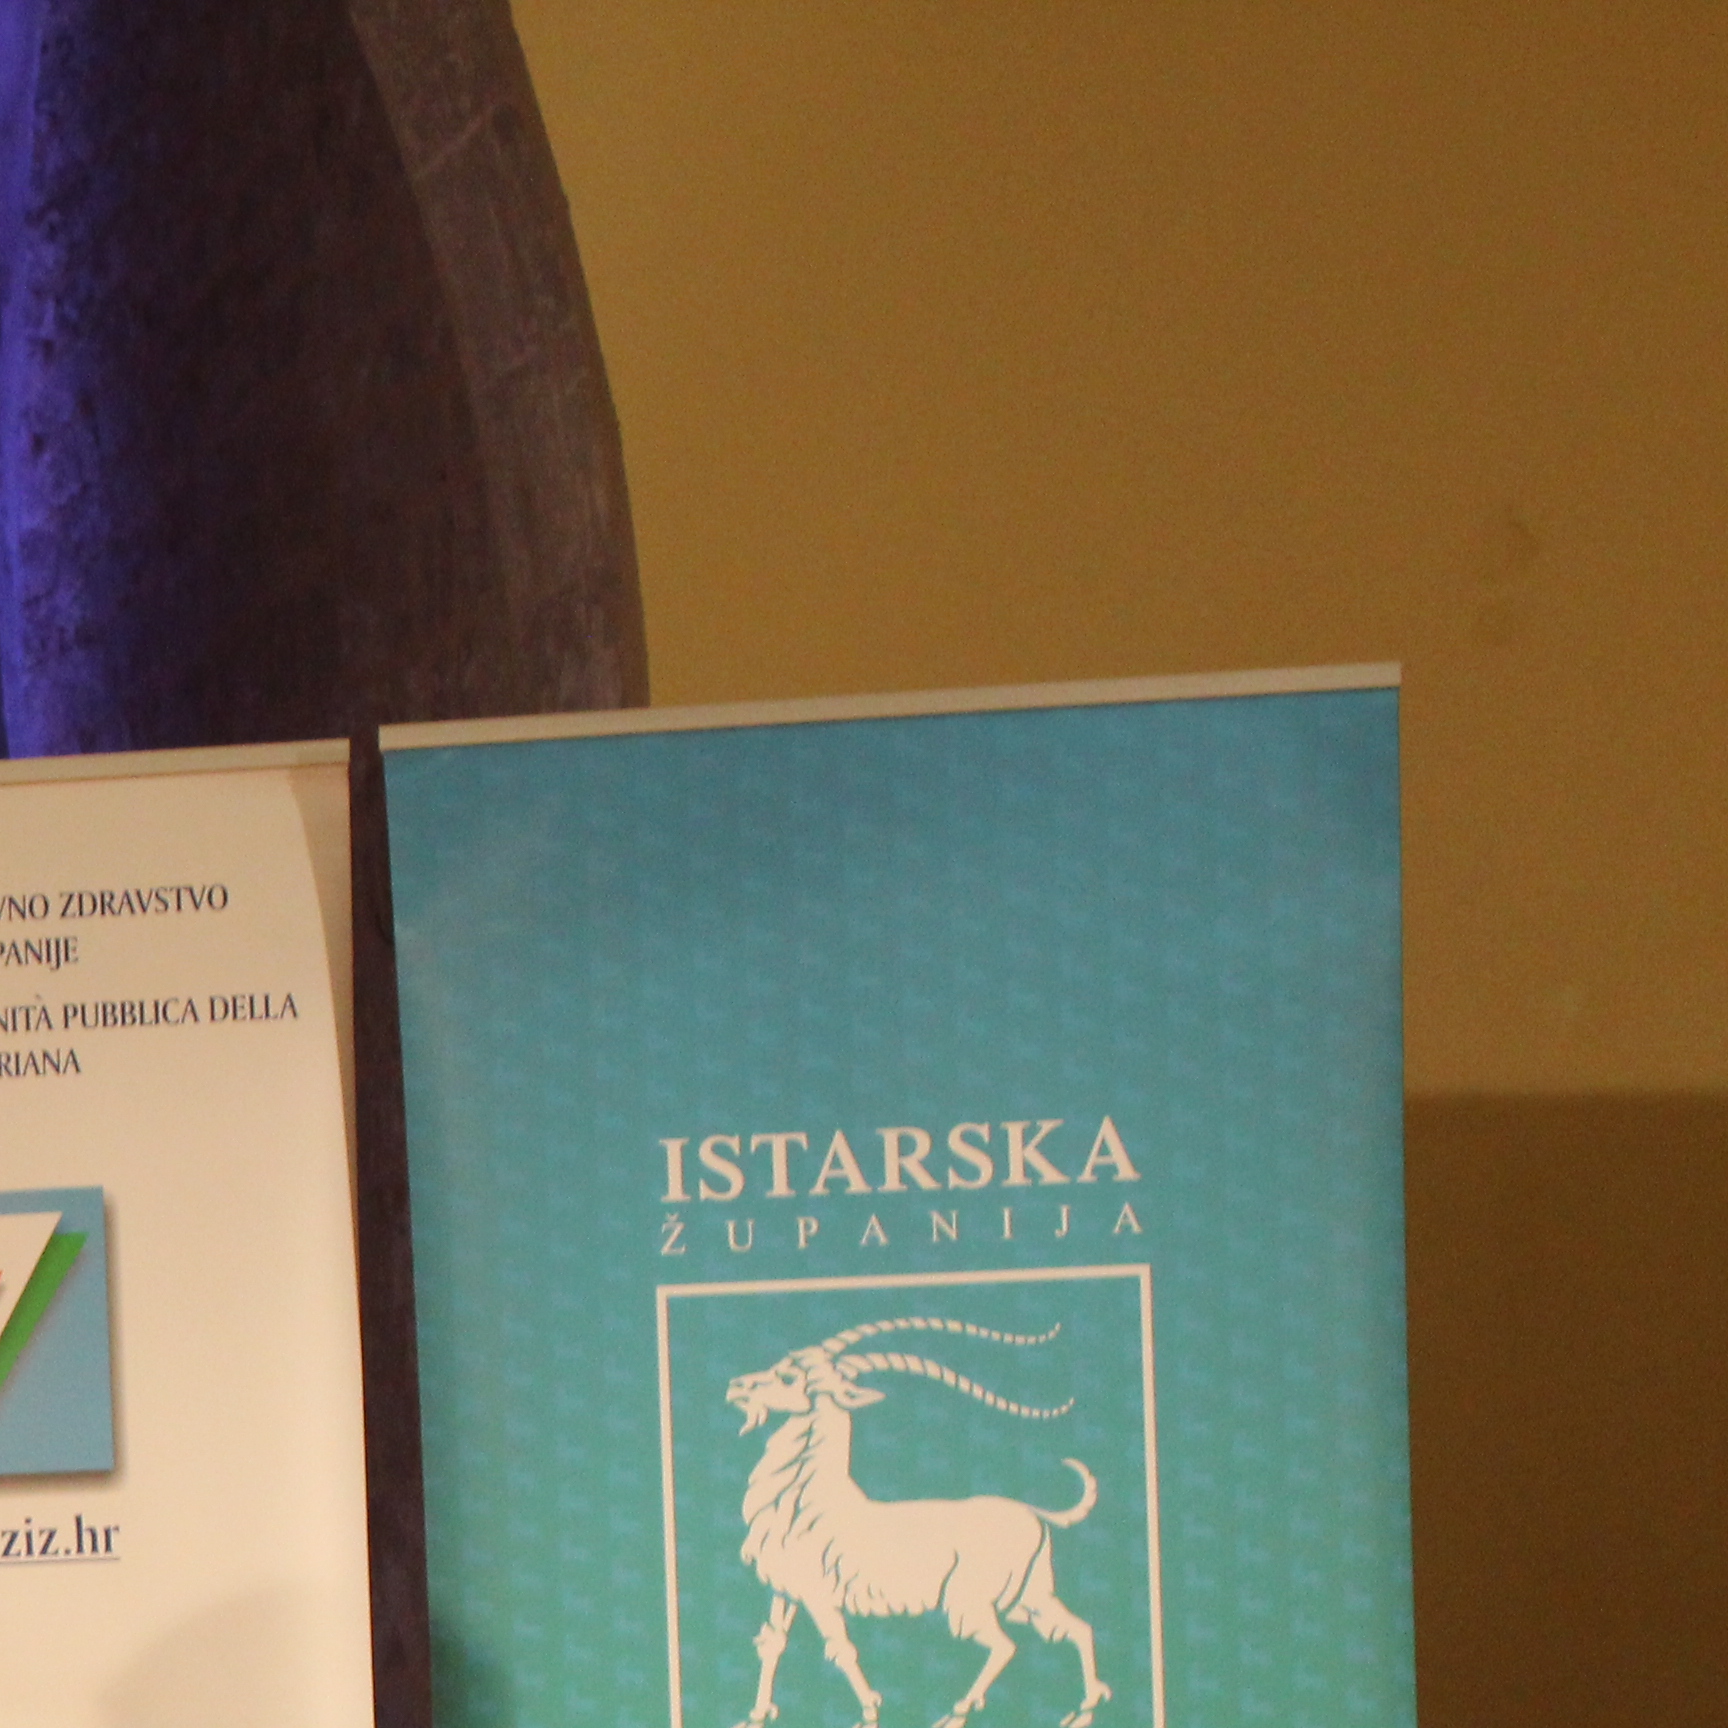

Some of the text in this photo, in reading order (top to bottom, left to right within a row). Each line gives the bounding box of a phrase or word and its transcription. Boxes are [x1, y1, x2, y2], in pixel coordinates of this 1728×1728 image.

[59, 884, 230, 919] ZDRAVSTVO
[62, 1000, 199, 1030] PUBBLICA
[208, 992, 298, 1022] DELLA
[659, 1115, 1141, 1202] ISTARSKA
[661, 1202, 1142, 1256] ŽUPANIJA
